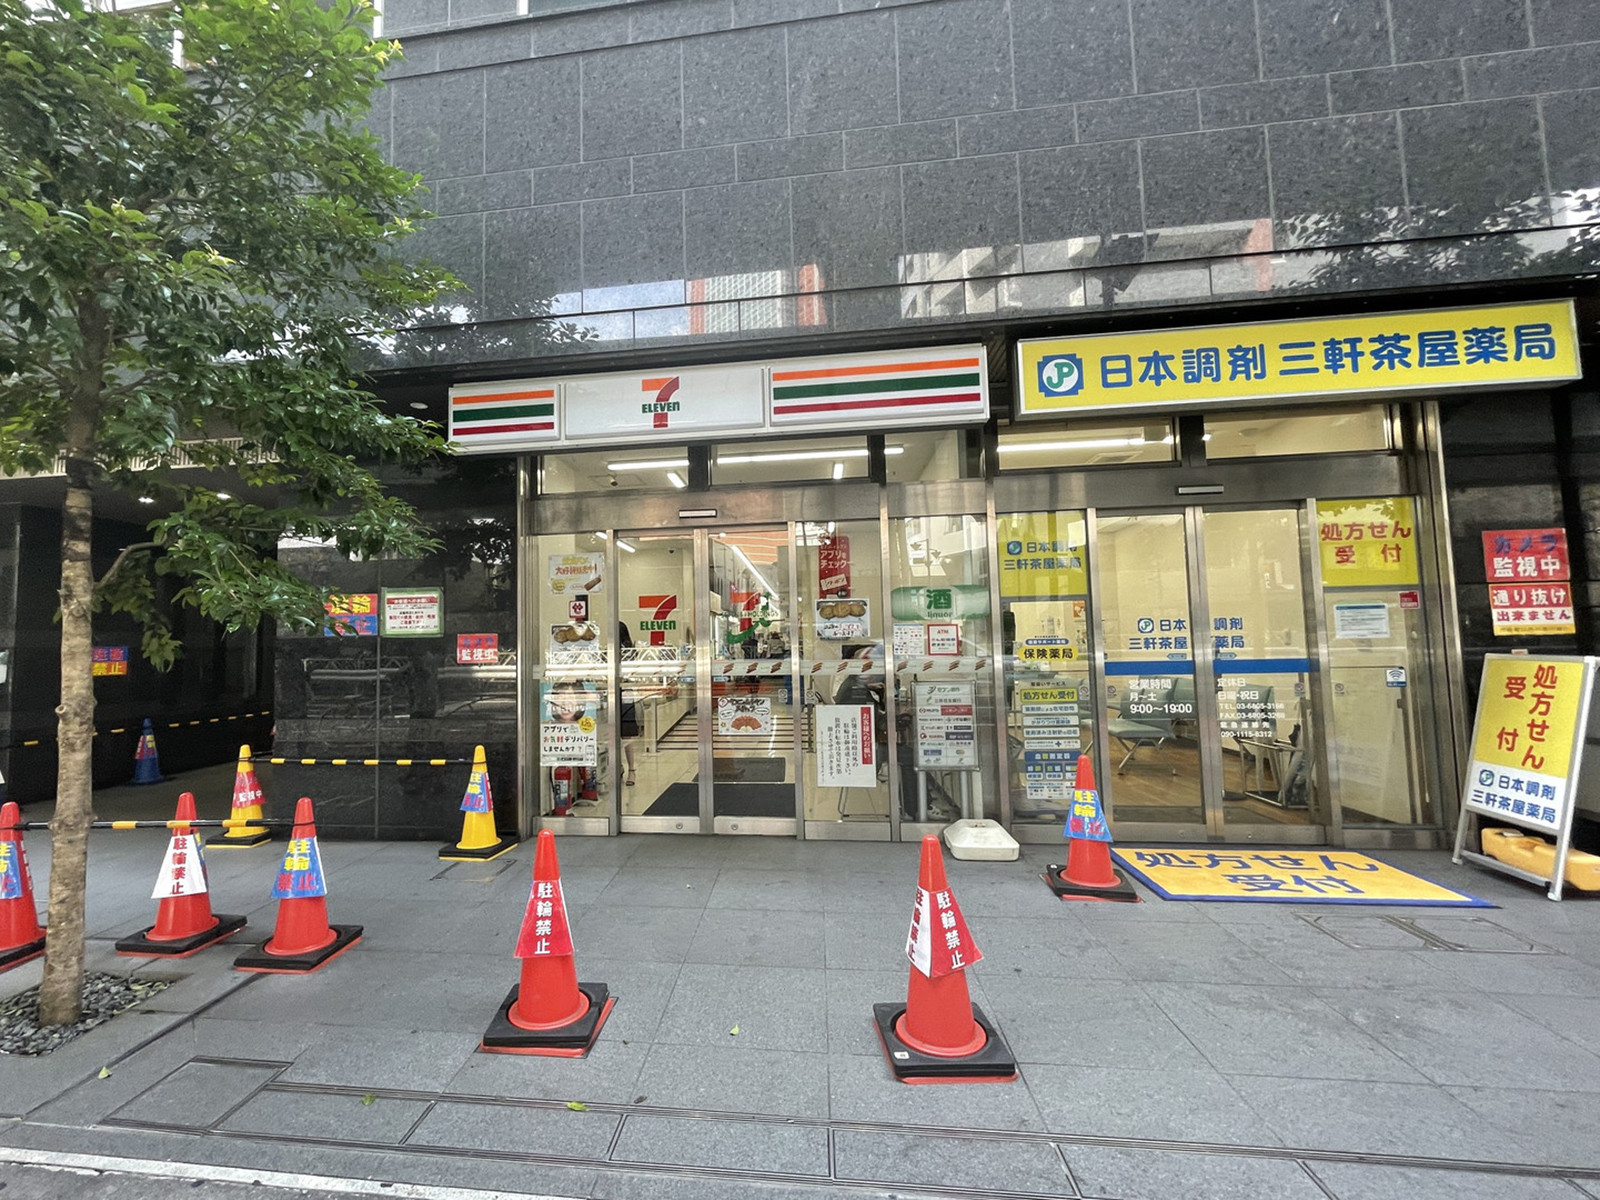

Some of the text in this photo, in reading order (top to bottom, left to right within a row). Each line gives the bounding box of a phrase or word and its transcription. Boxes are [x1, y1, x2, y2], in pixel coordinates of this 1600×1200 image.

[1100, 345, 1267, 388] 日本調剤
[1278, 323, 1558, 376] 三軒茶屋薬局
[1321, 521, 1412, 541] 処方せん
[1335, 543, 1402, 564] 受付
[1494, 534, 1558, 554] カメラ
[820, 560, 847, 569] チェック
[1004, 557, 1081, 570] 三軒茶屋薬局
[1493, 555, 1561, 577] 監視中
[926, 588, 952, 609] 酒
[1493, 588, 1567, 606] 通り抜け
[1159, 619, 1187, 631] 日本
[1213, 617, 1243, 631] 調剤
[1497, 609, 1571, 622] 出来ません
[1129, 636, 1245, 650] 三軒茶屋 薬局
[461, 648, 497, 661] 監視中
[1023, 648, 1073, 659] 保険薬局
[93, 662, 123, 676] 禁止
[1129, 679, 1172, 690] 営業時間
[1217, 678, 1246, 687] 定休日
[1023, 691, 1075, 700] 処方せん受付
[1497, 676, 1527, 752] 受付
[1521, 664, 1557, 769] 処方せん
[863, 713, 872, 759] お客様へのお願い
[1498, 775, 1557, 801] 日本調剤
[1471, 789, 1556, 824] 三軒茶屋薬局
[170, 837, 188, 895] 駐輪禁止
[1134, 850, 1380, 872] 処方せん
[1221, 874, 1367, 894] 受付
[534, 882, 553, 955] 駐輪禁止
[936, 890, 966, 970] 駐輪禁止
